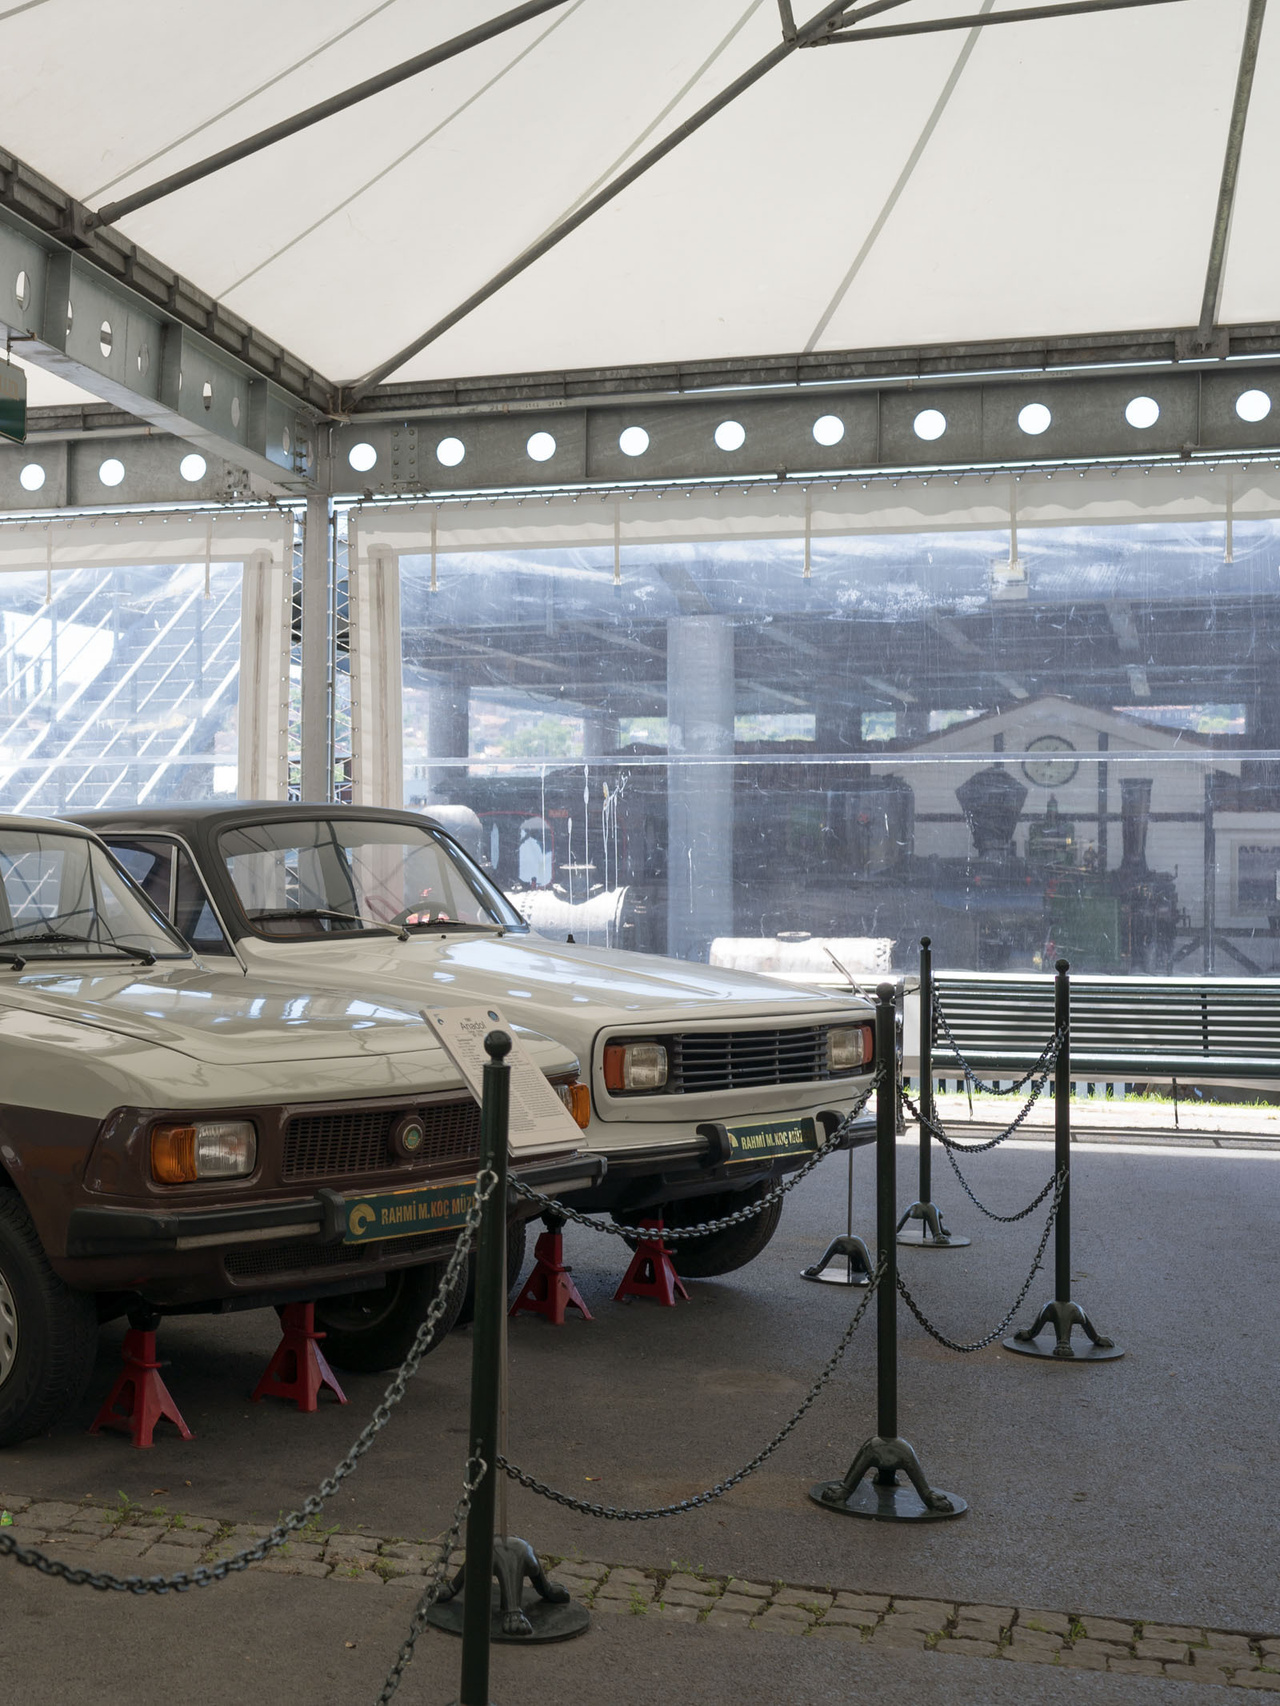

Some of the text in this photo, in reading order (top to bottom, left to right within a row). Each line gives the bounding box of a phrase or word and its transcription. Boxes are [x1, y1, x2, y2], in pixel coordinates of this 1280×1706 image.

[460, 1021, 487, 1031] Anadol
[741, 1131, 767, 1150] RAHMİ
[381, 1201, 417, 1226] RAHMİ
